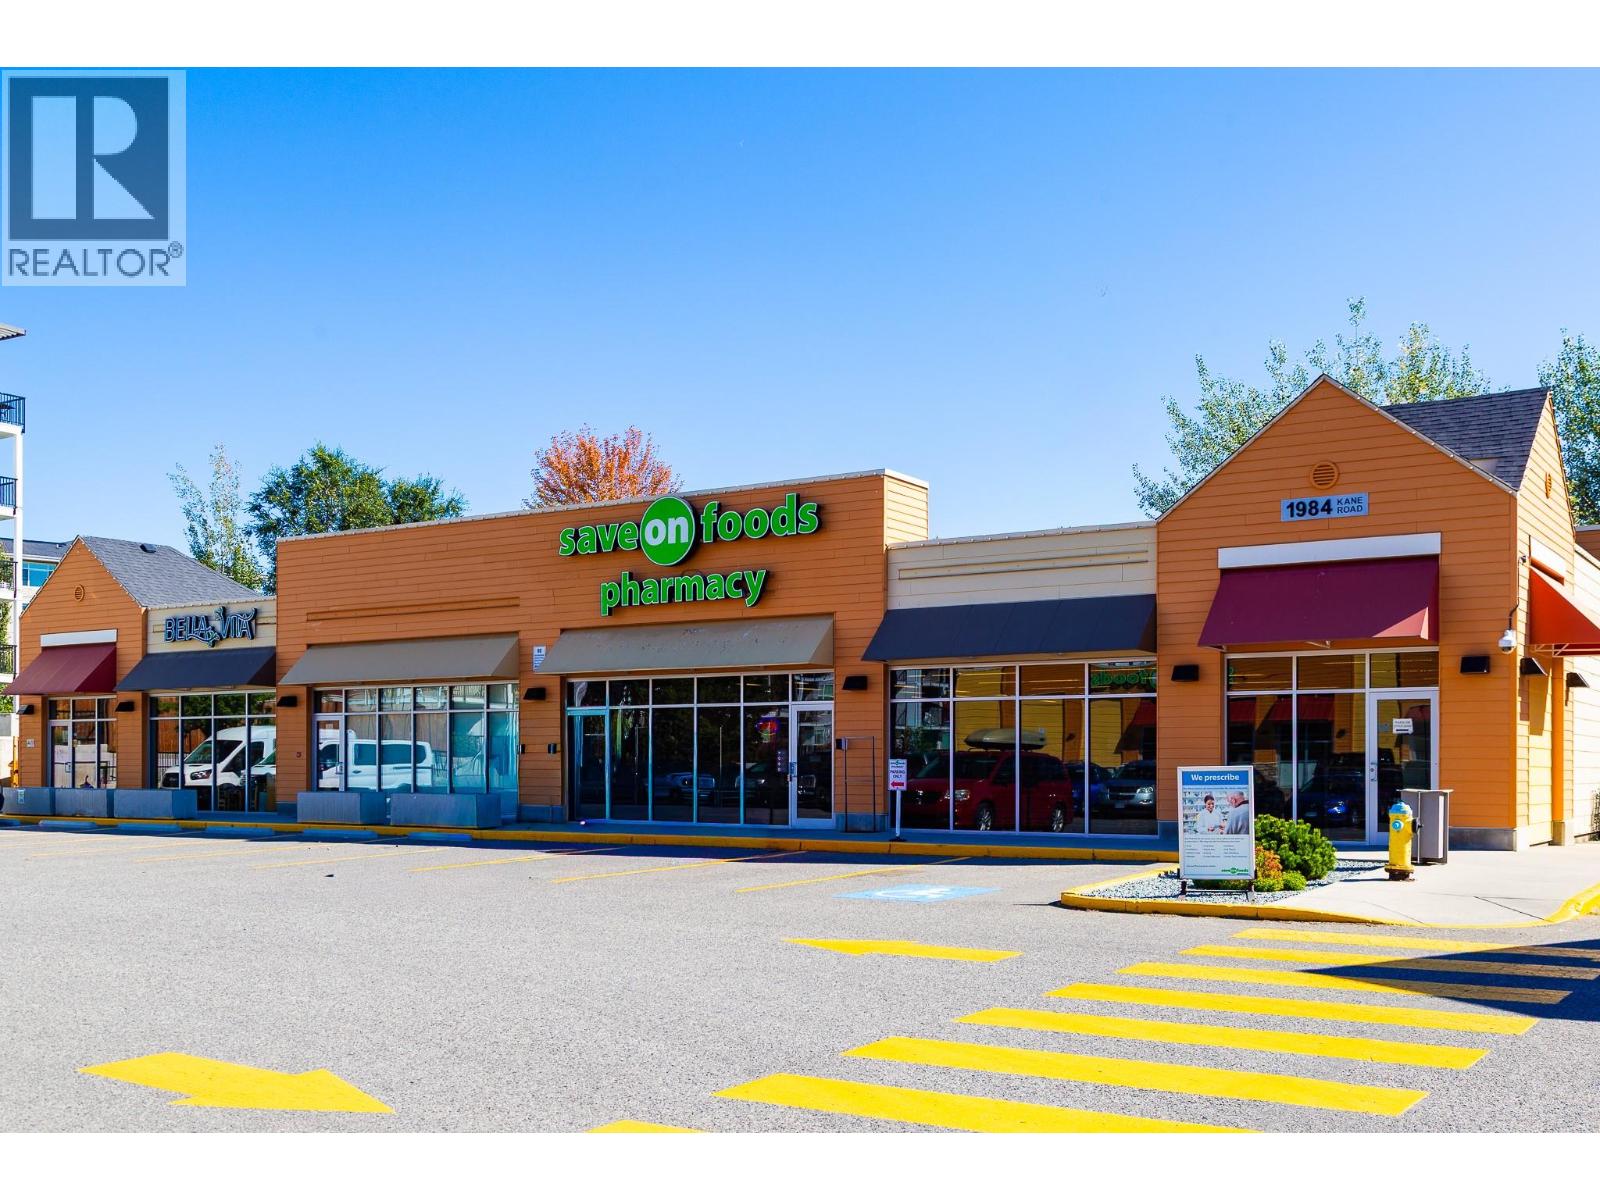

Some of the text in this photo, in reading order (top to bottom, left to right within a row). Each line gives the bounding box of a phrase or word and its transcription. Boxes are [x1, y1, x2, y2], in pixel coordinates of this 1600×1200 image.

[1286, 498, 1333, 518] 1984
[1336, 496, 1363, 506] KANE
[1336, 505, 1363, 514] ROAD
[558, 493, 820, 556] save on foods
[600, 569, 767, 616] pharmacy
[164, 606, 258, 643] BELLA VITA
[1204, 773, 1240, 783] prescribe
